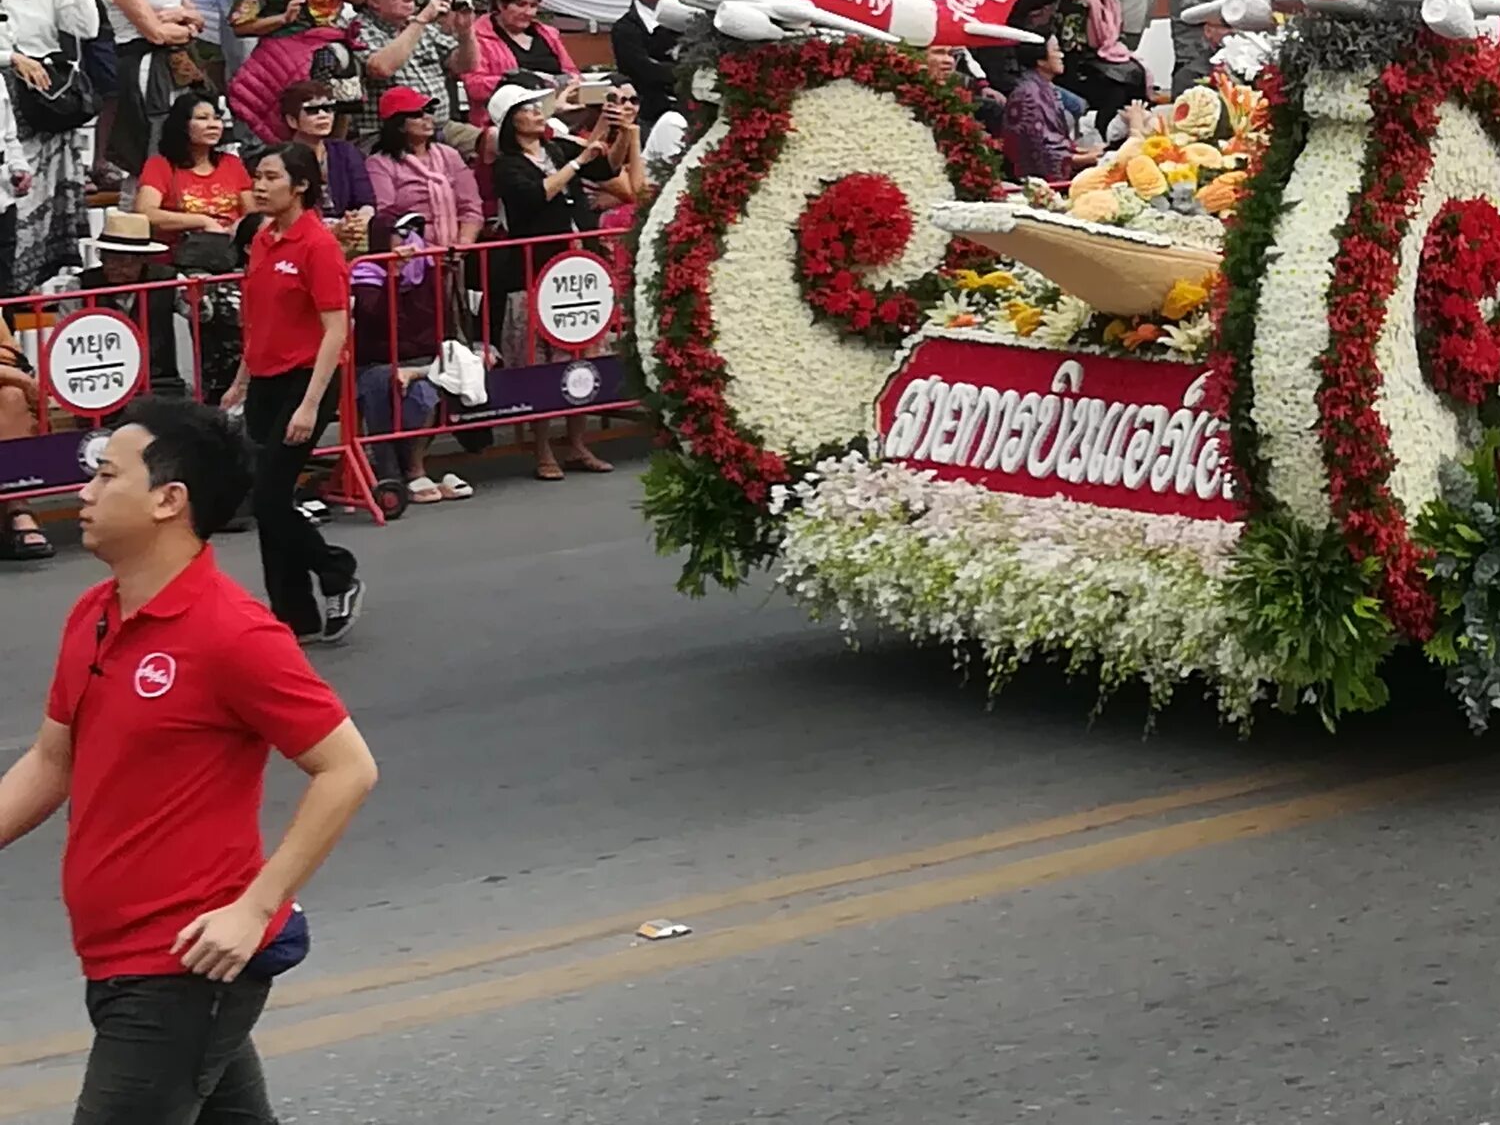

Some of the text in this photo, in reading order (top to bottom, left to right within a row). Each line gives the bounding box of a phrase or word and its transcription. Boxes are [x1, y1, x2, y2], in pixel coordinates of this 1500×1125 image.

[552, 272, 598, 300] หยุด
[553, 309, 601, 329] ตรวจ
[66, 331, 121, 362] หยุด
[68, 371, 124, 394] ตรวจ
